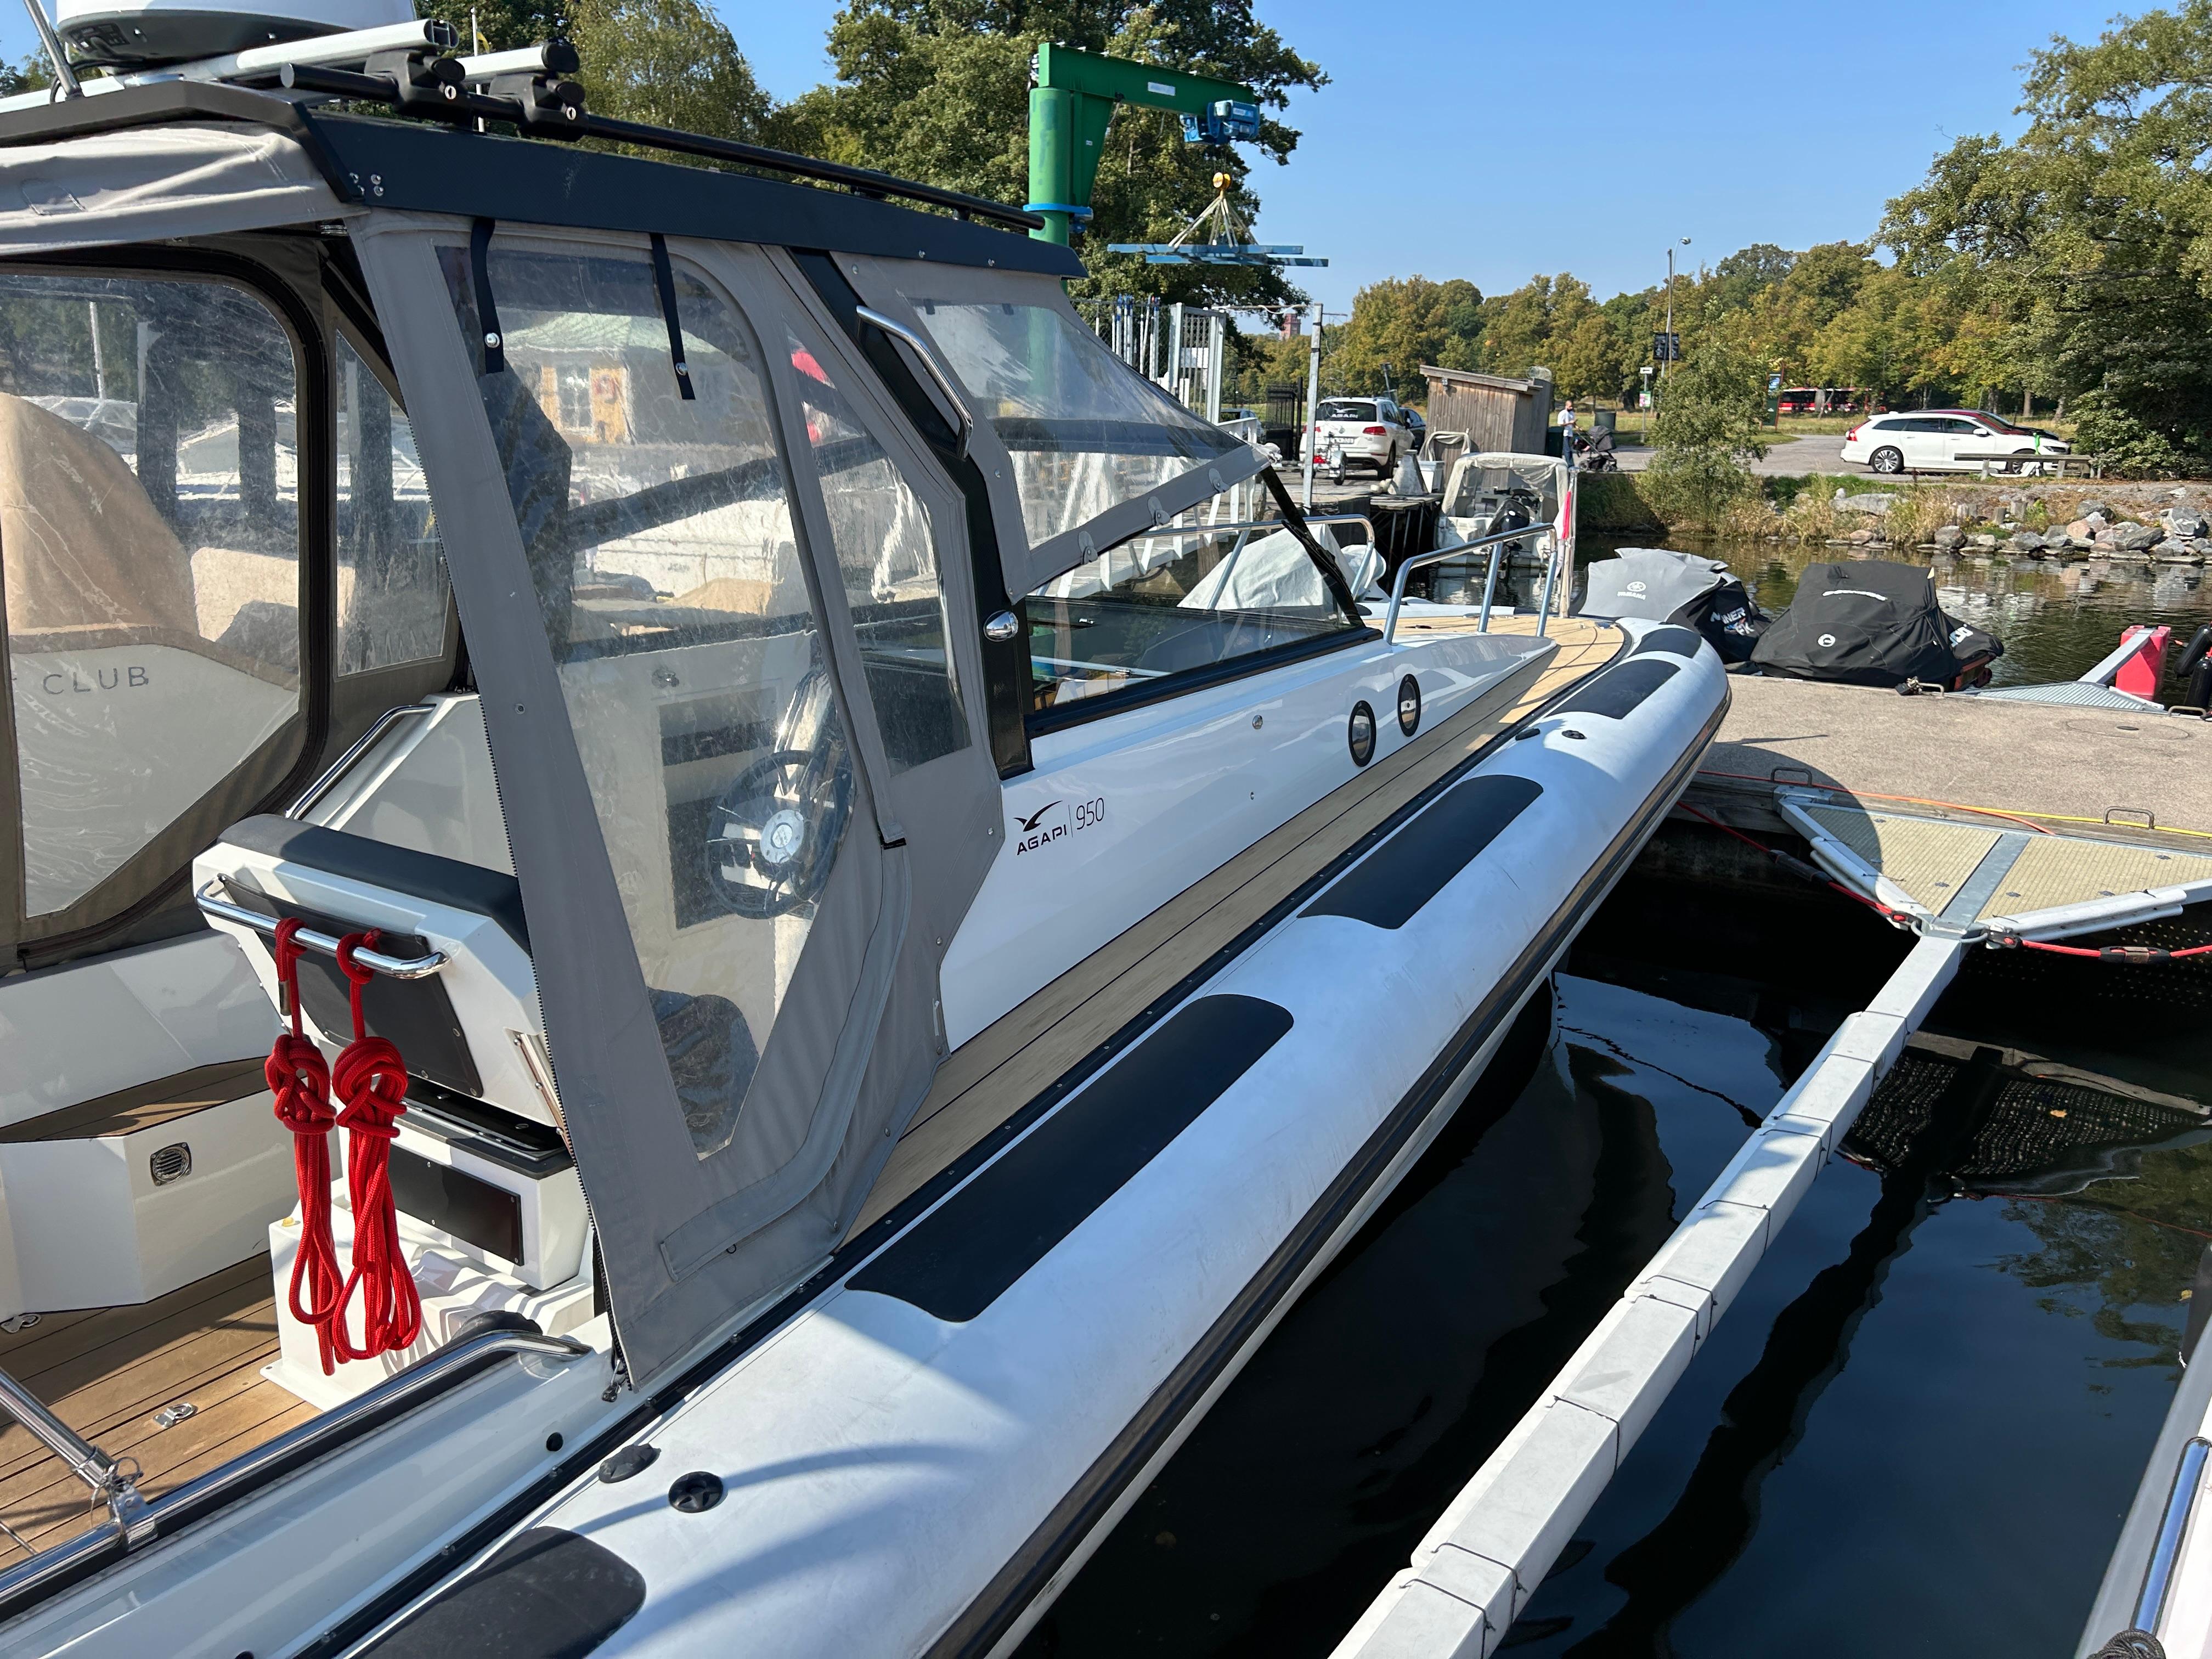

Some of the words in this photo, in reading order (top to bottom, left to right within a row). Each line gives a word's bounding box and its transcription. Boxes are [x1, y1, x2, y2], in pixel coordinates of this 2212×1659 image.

[43, 667, 149, 695] CLUB
[1017, 824, 1067, 856] AGAPI
[1076, 797, 1104, 830] 950
